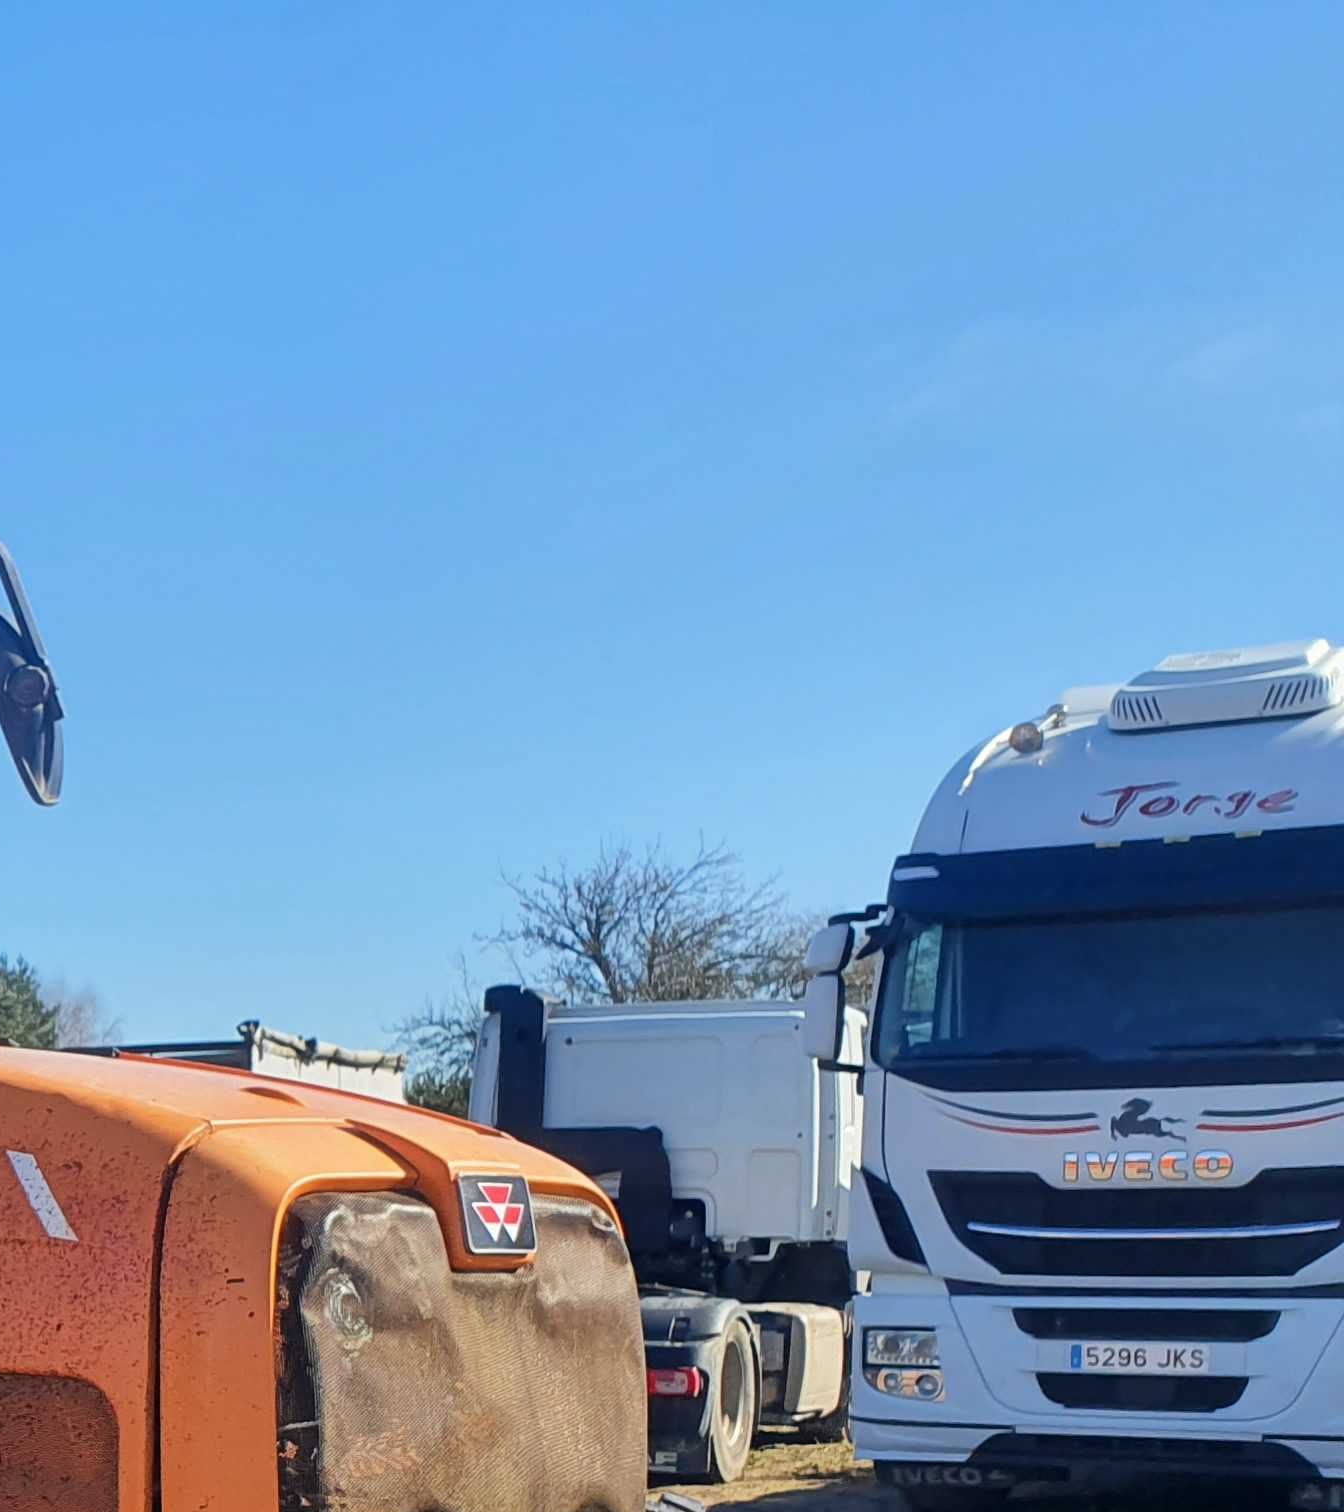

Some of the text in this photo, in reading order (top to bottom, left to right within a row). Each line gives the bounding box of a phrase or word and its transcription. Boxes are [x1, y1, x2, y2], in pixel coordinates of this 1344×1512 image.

[1064, 1150, 1233, 1182] IVECO
[1086, 1346, 1205, 1369] 5296 JKS
[892, 1466, 983, 1485] IVECO
